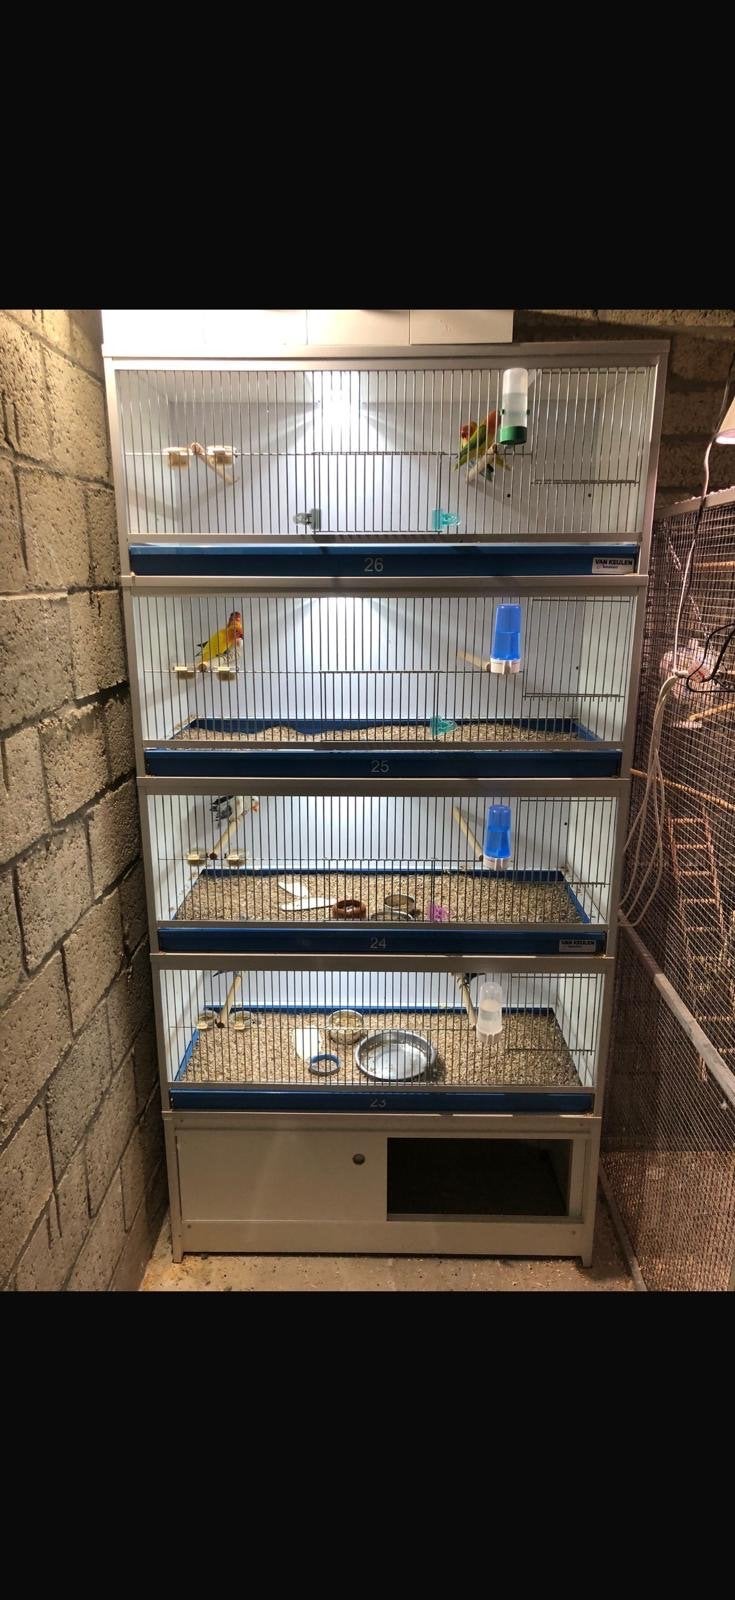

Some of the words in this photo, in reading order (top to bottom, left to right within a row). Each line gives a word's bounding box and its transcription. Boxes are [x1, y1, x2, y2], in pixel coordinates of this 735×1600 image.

[364, 557, 384, 572] 26
[371, 760, 389, 773] 25
[370, 937, 386, 949] 24
[370, 1097, 386, 1108] 23
